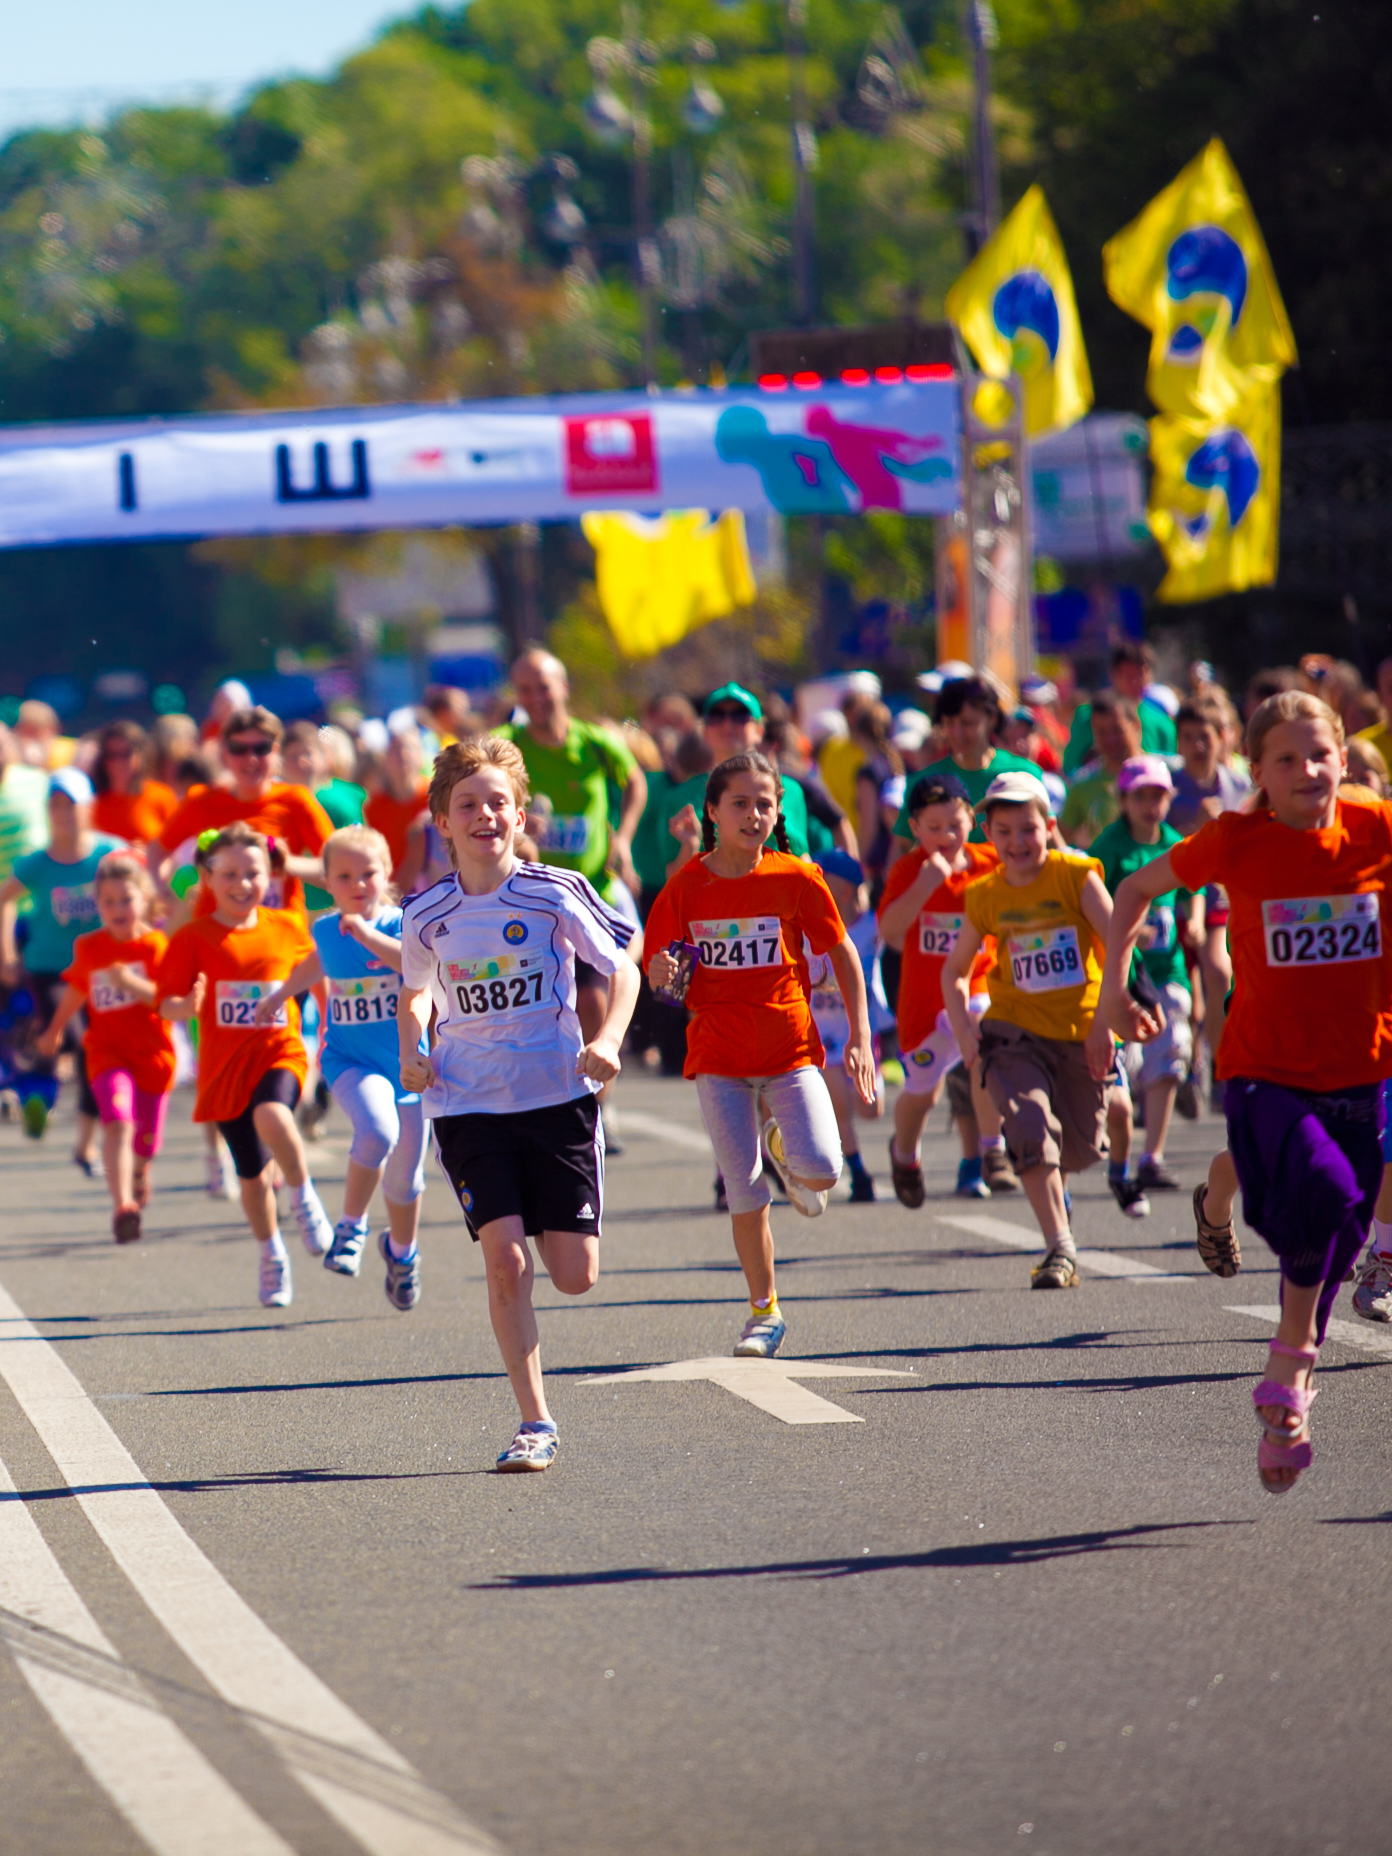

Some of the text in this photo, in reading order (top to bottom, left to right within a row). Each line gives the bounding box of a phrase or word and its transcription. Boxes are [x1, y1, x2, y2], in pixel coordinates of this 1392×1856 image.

[699, 937, 779, 966] 02417
[1272, 921, 1379, 962] 02324
[1013, 947, 1079, 982] 07669
[333, 994, 398, 1021] 01813
[456, 971, 543, 1014] 03827
